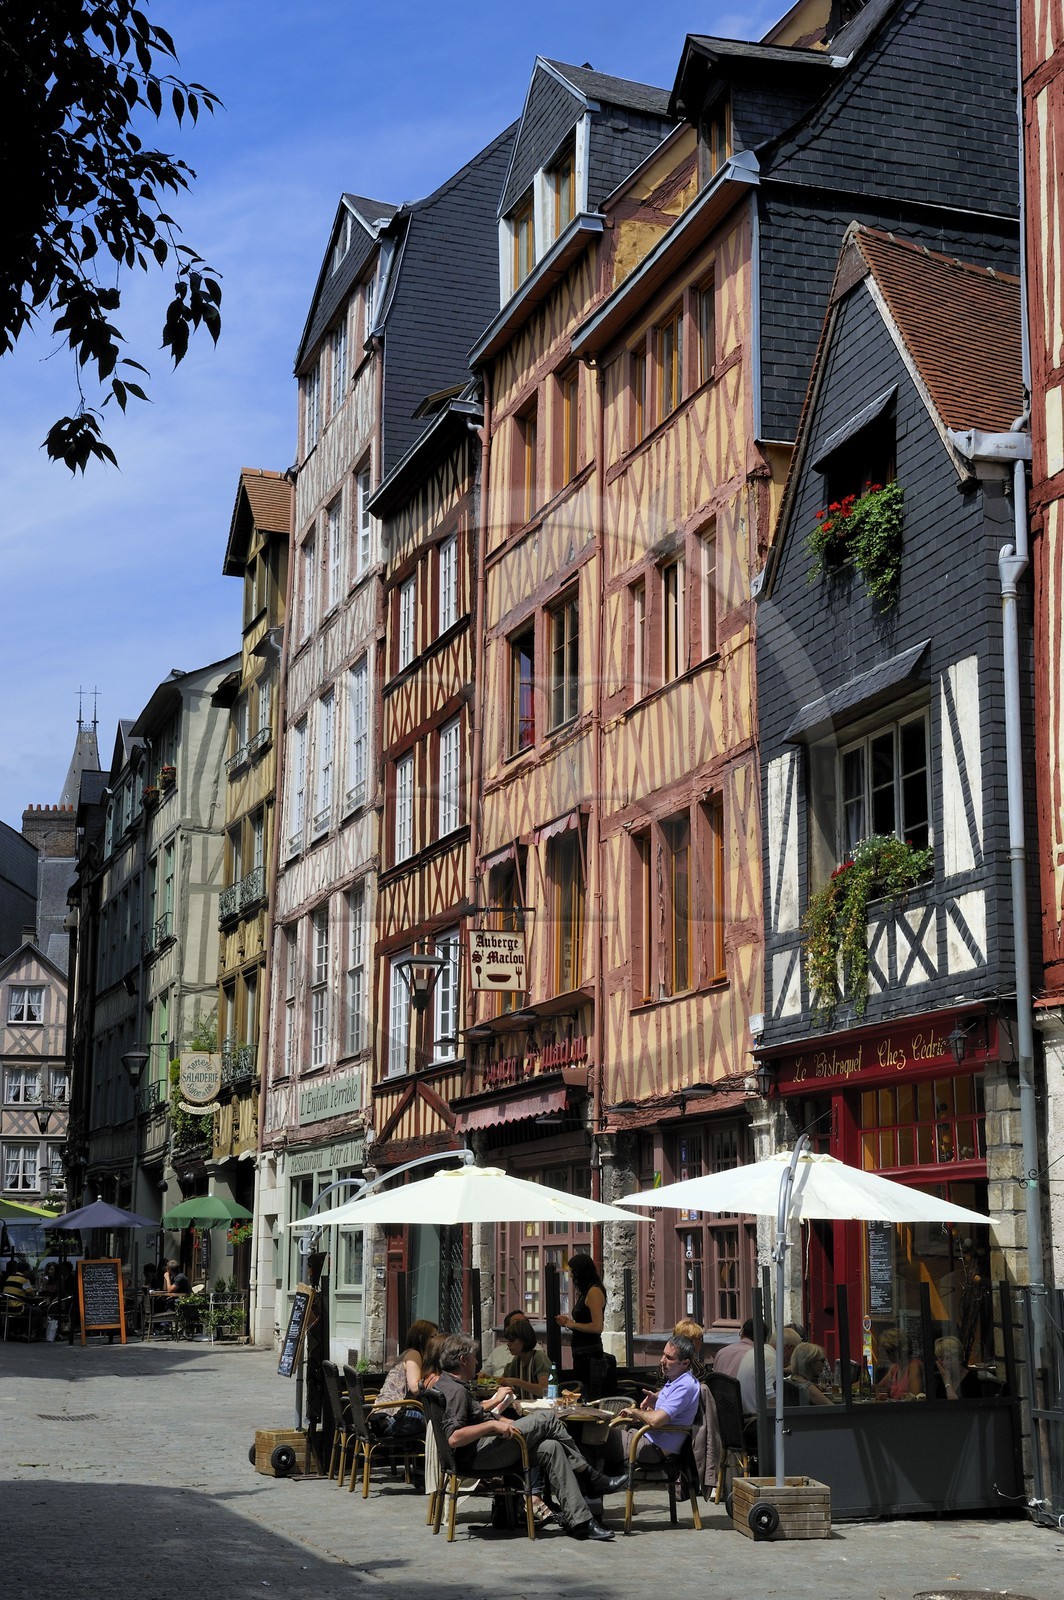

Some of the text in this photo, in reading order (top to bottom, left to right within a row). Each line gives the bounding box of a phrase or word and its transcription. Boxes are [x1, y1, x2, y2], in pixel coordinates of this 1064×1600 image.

[475, 934, 519, 951] Auberge
[471, 950, 525, 965] St Maclou
[793, 1029, 947, 1083] Le Bistroquet Chez Cédric
[187, 1058, 213, 1071] Tarterie
[181, 1072, 218, 1083] SALADERIE
[187, 1083, 201, 1098] Salon
[299, 1077, 358, 1119] L'Enfant Terrible
[290, 1150, 323, 1173] Restaurant
[329, 1144, 343, 1167] Bar
